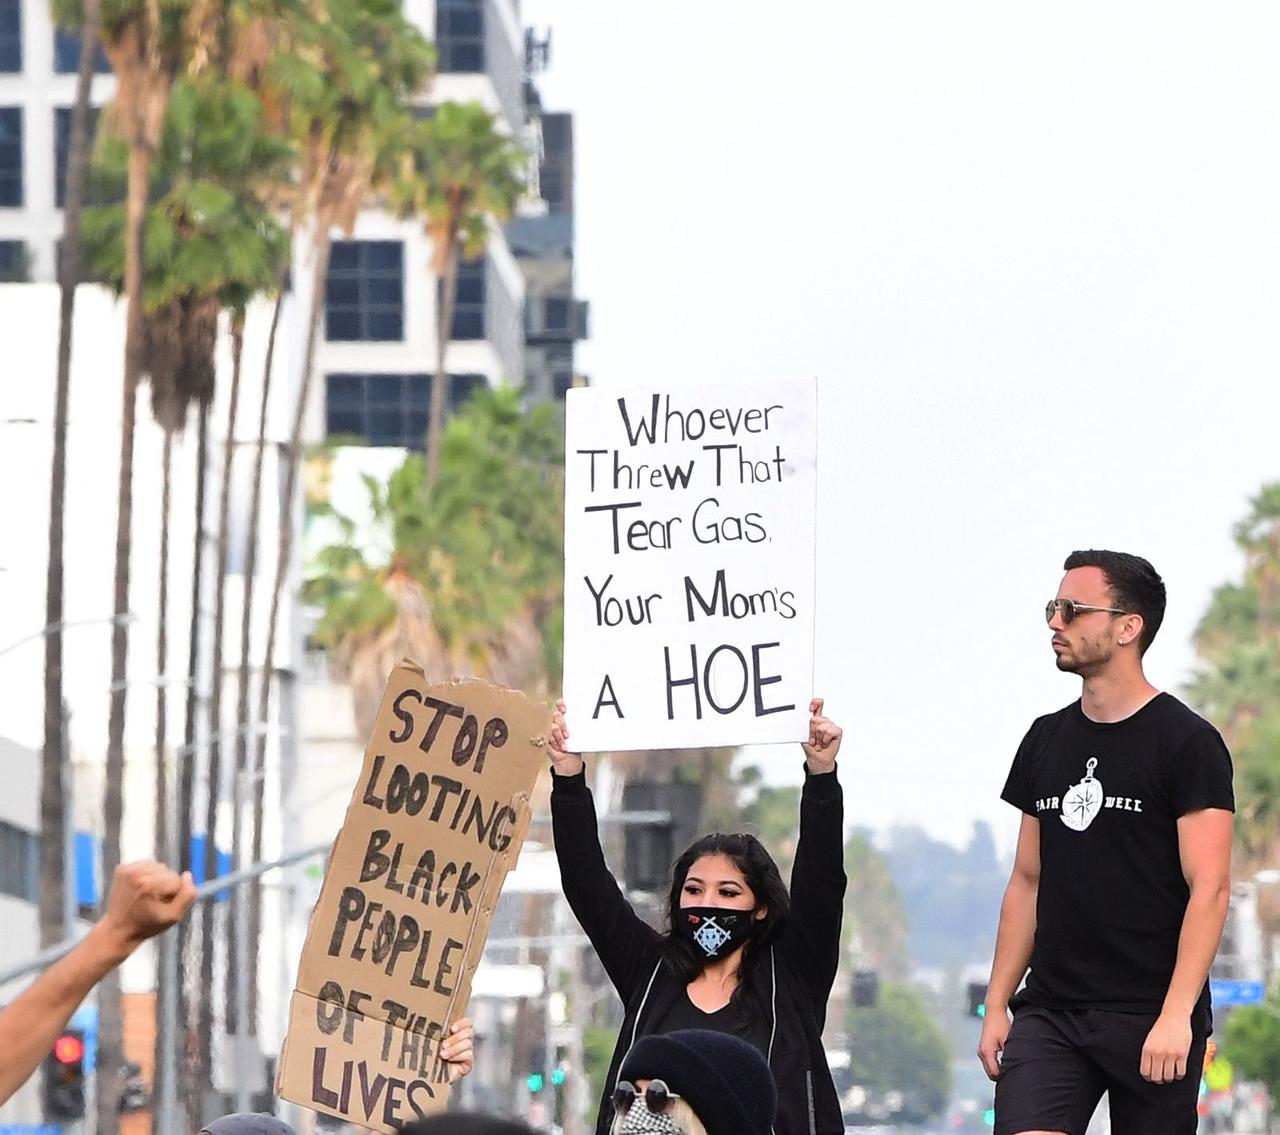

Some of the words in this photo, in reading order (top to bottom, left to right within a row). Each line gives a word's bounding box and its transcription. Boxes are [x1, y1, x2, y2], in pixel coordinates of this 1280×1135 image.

[617, 393, 784, 446] Whoever
[576, 450, 695, 492] Threw
[702, 443, 786, 487] That
[584, 501, 682, 554] Tear
[583, 574, 663, 627] Your
[683, 569, 797, 623] Mom's
[592, 674, 625, 719] A
[663, 641, 796, 720] HOE
[388, 688, 509, 774] STOP
[363, 755, 517, 852] LOOTING
[1103, 796, 1144, 813] WELL
[359, 829, 481, 915] BLACK
[327, 886, 464, 997] PEOPLE
[316, 980, 372, 1045] OF
[312, 1046, 436, 1130] LIVES
